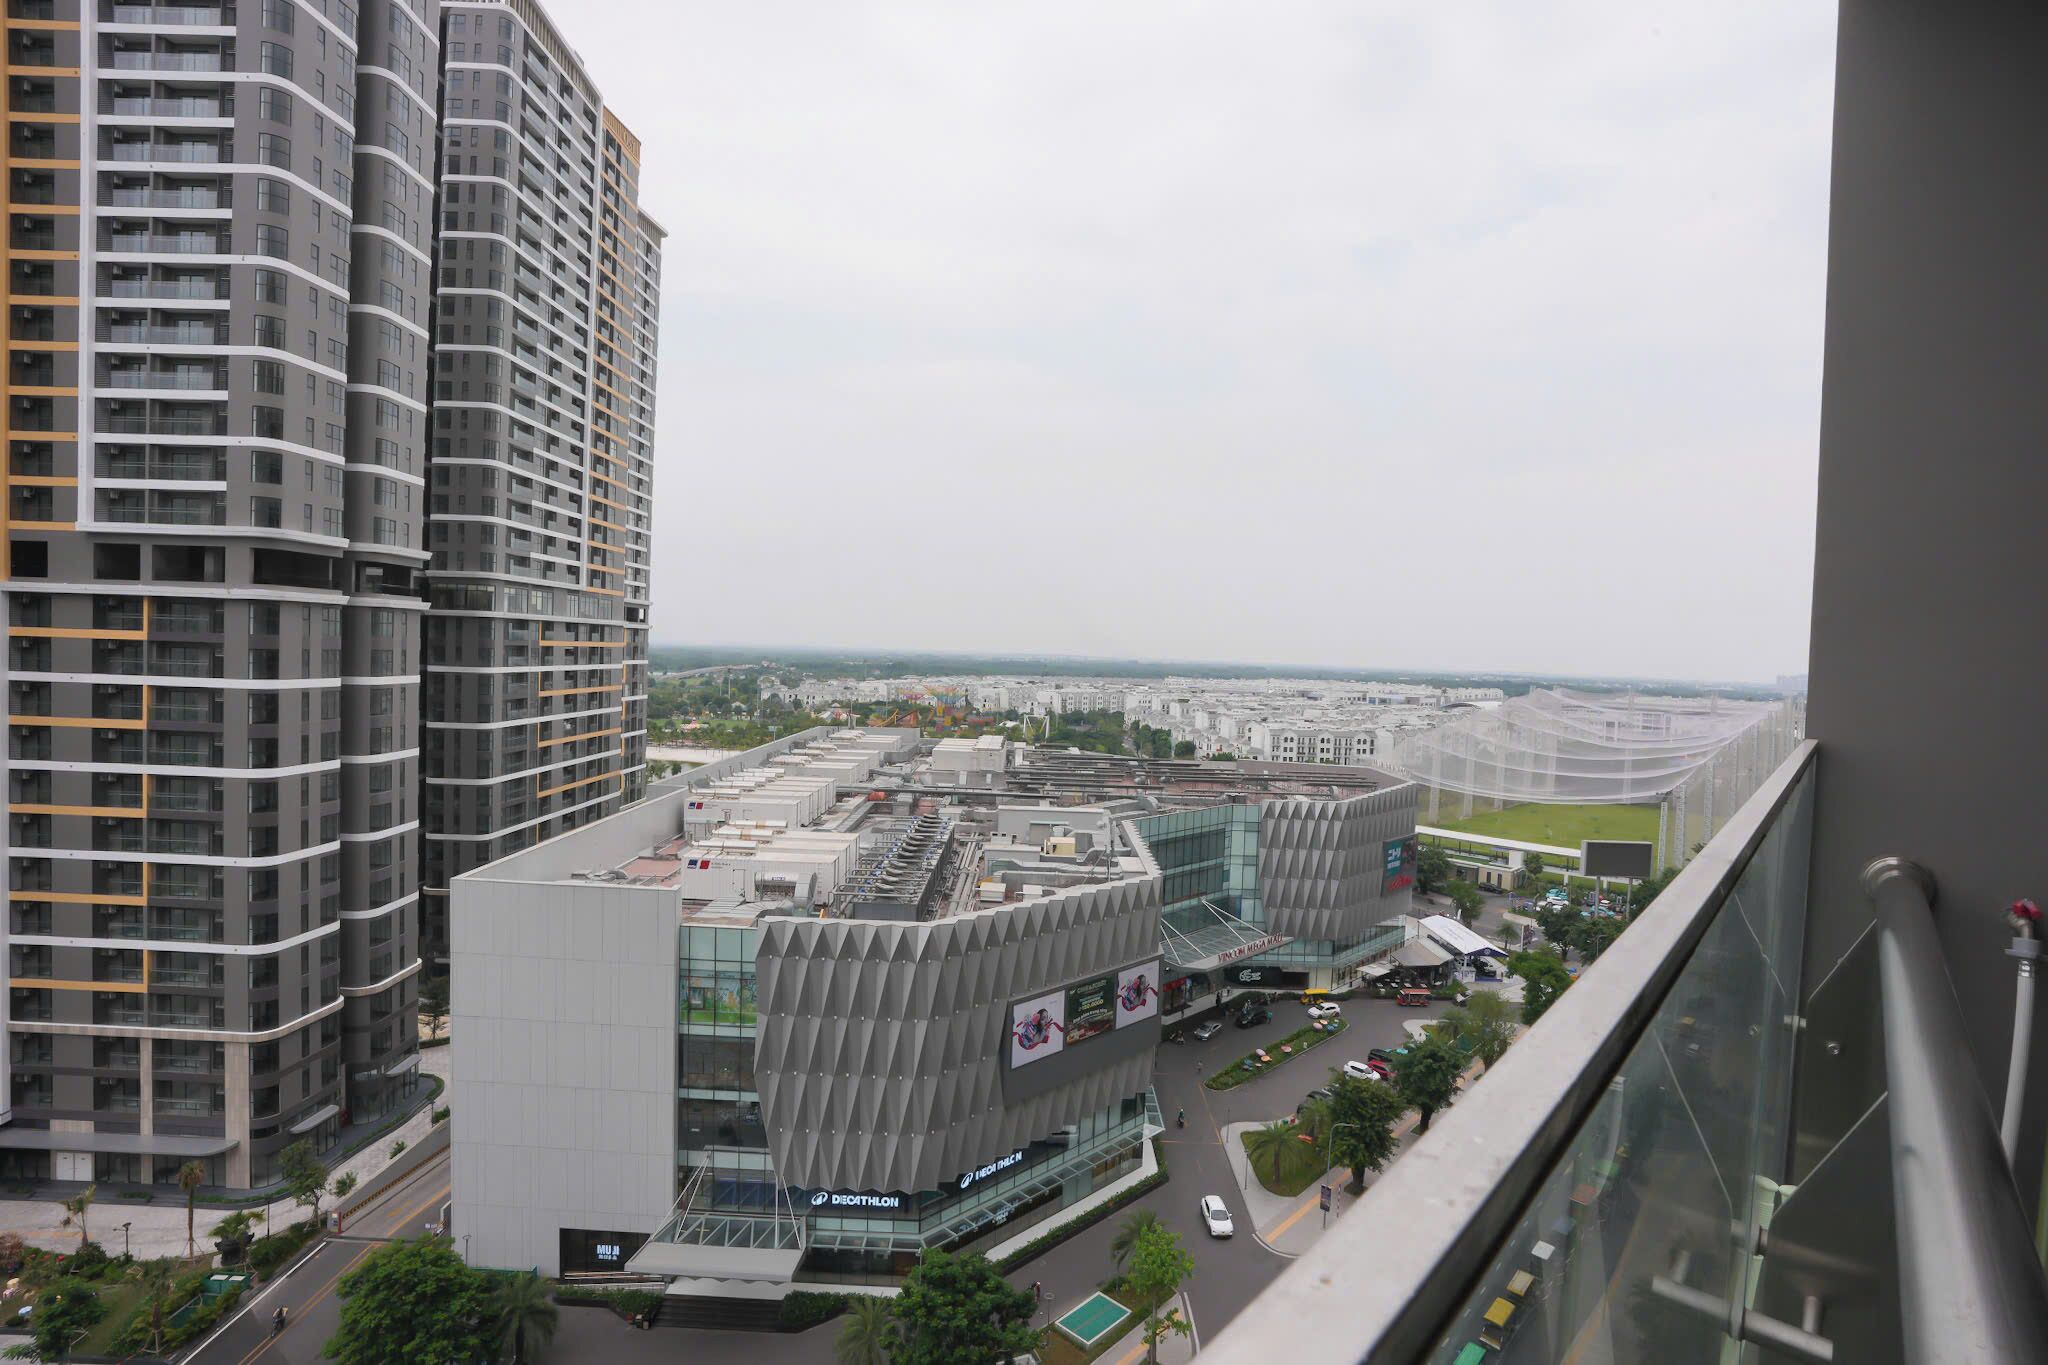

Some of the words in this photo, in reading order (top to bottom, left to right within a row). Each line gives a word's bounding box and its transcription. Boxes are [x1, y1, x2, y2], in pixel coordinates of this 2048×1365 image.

[1218, 946, 1245, 962] VINCOM
[1247, 940, 1266, 953] MEGA
[832, 1194, 899, 1207] DECATHLON
[596, 1244, 620, 1255] MUJI
